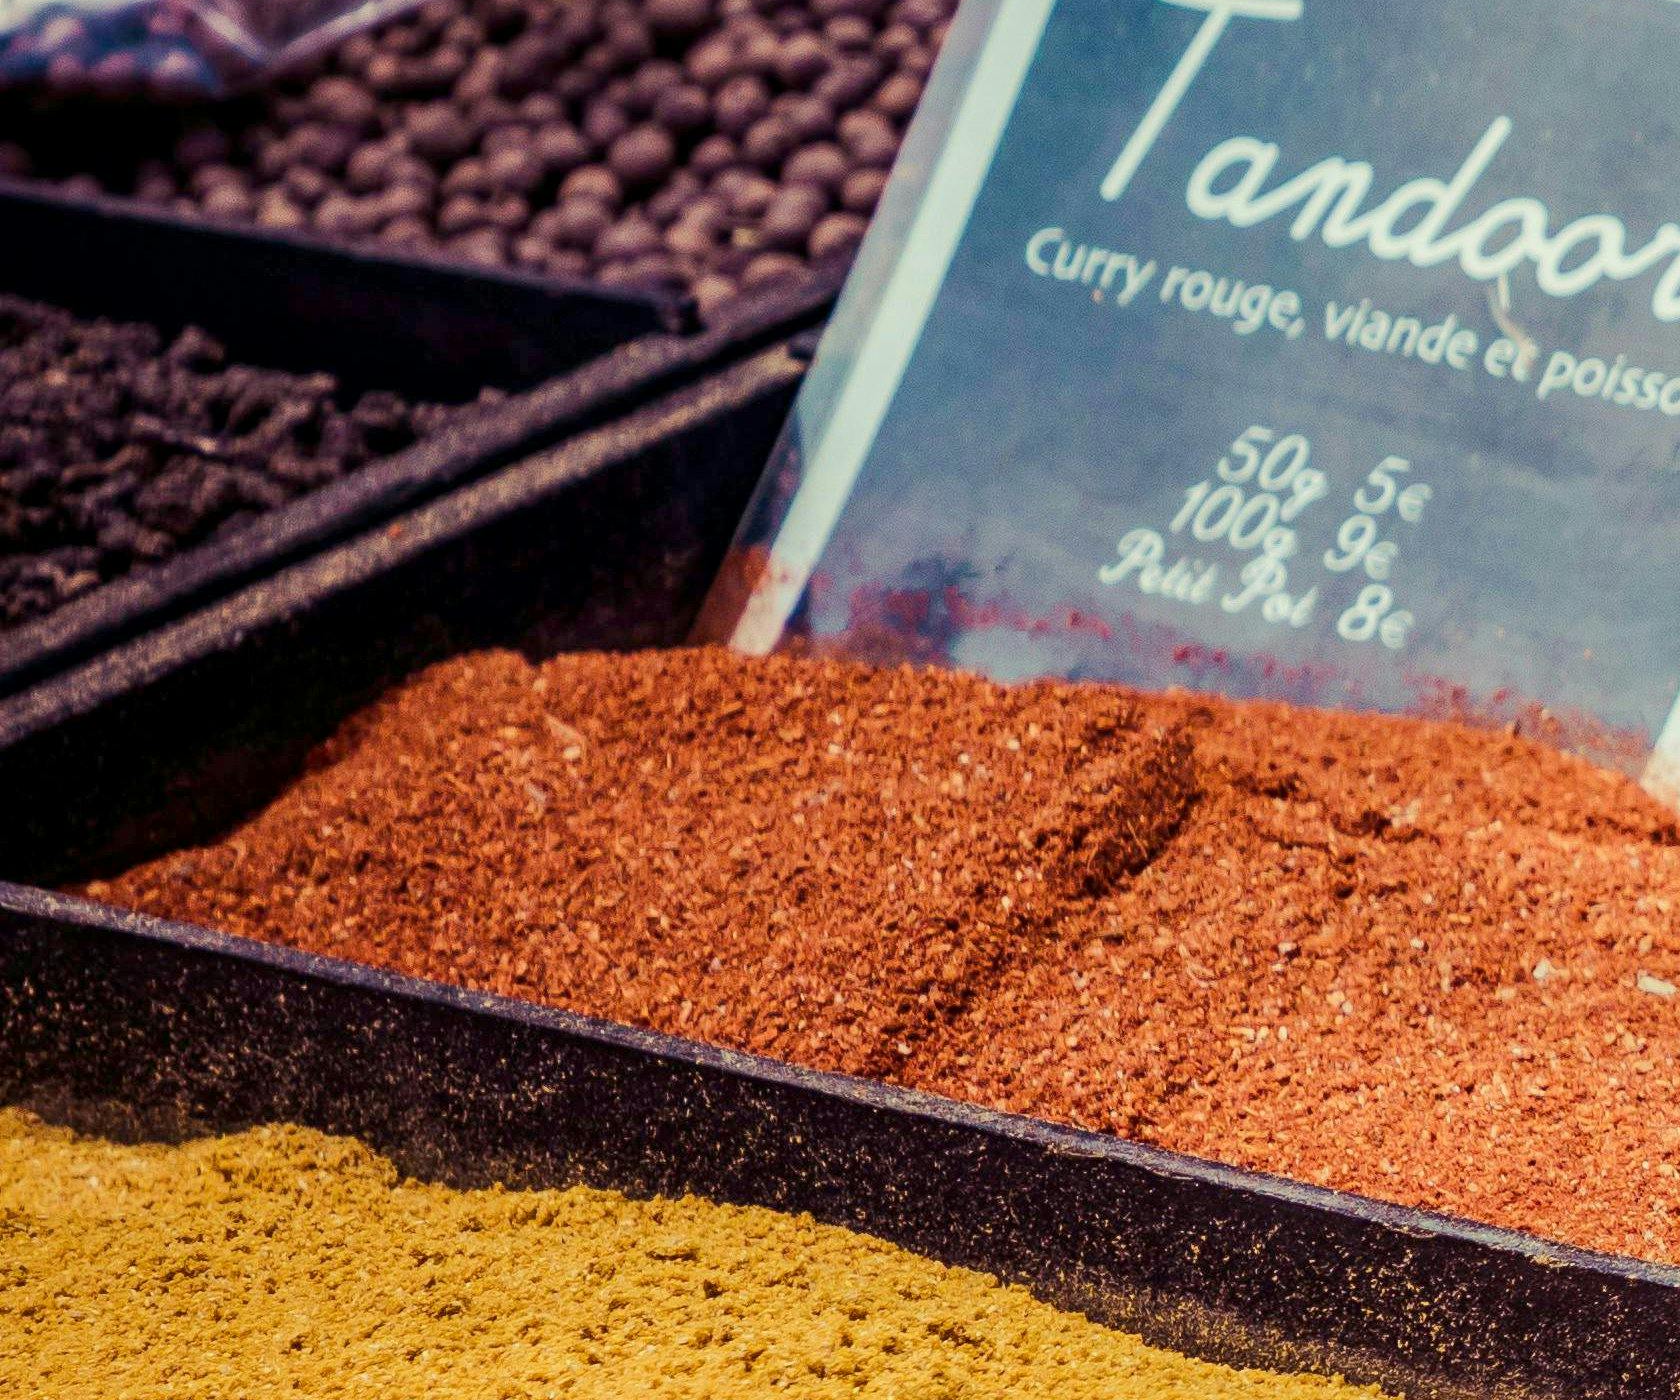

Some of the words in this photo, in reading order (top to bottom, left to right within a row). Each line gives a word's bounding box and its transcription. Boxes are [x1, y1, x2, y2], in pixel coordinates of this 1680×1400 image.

[1024, 224, 1157, 305] Curry
[1159, 266, 1305, 339] rouge,
[1323, 297, 1475, 370] viande
[1483, 337, 1536, 380] et
[1217, 426, 1327, 522] 50g
[1354, 455, 1433, 522] 5€
[1169, 480, 1297, 565] 100g
[1323, 514, 1399, 581] 9€
[1099, 528, 1219, 605] Petit
[1221, 555, 1318, 628] Pot
[1337, 584, 1414, 649] 8€
